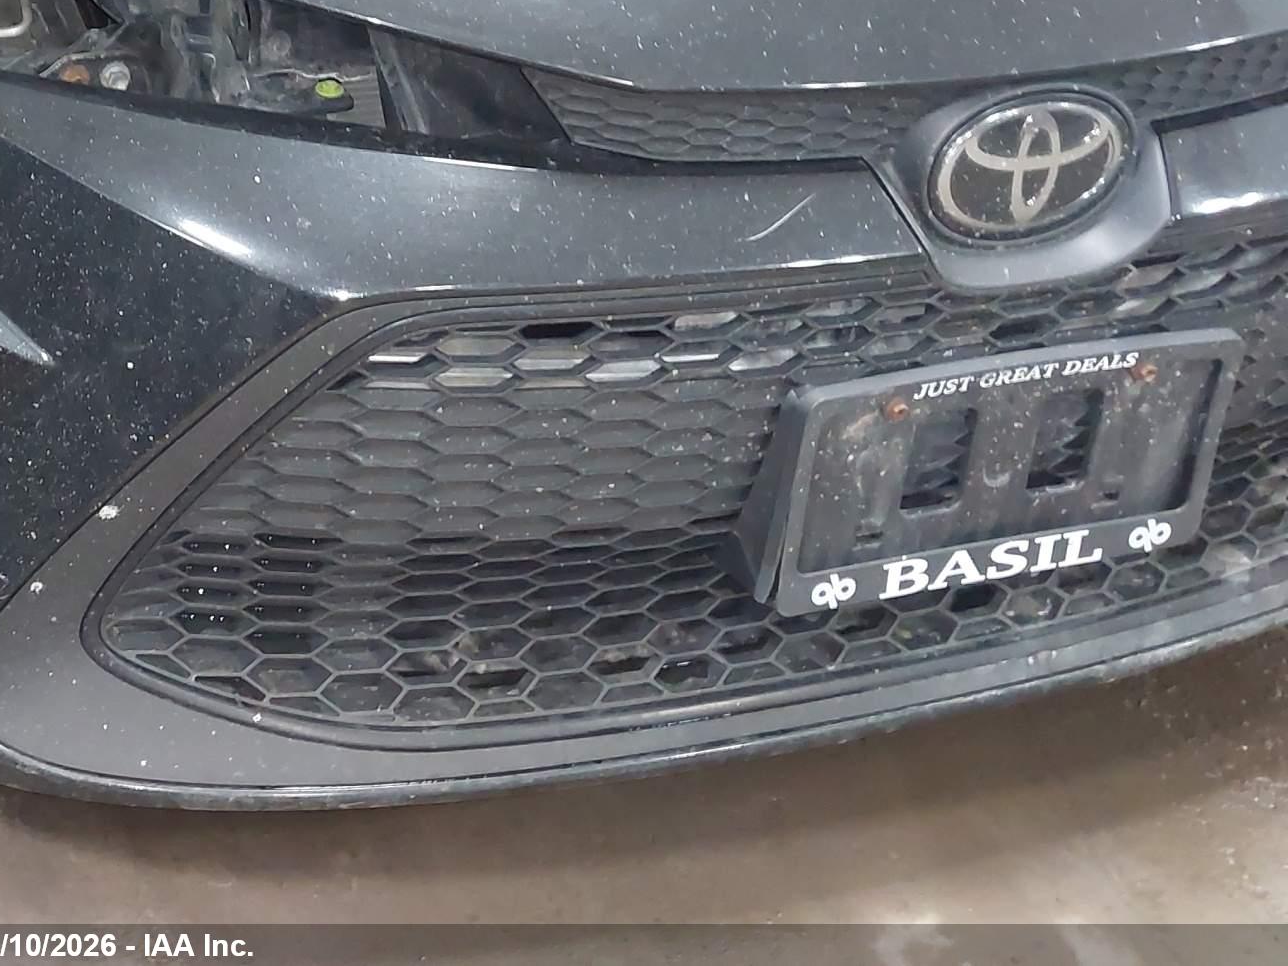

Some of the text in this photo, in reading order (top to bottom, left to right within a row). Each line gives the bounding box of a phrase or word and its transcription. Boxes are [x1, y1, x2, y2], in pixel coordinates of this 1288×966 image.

[913, 352, 1139, 400] JUST GREAT DEALS
[879, 529, 1103, 600] BASIL
